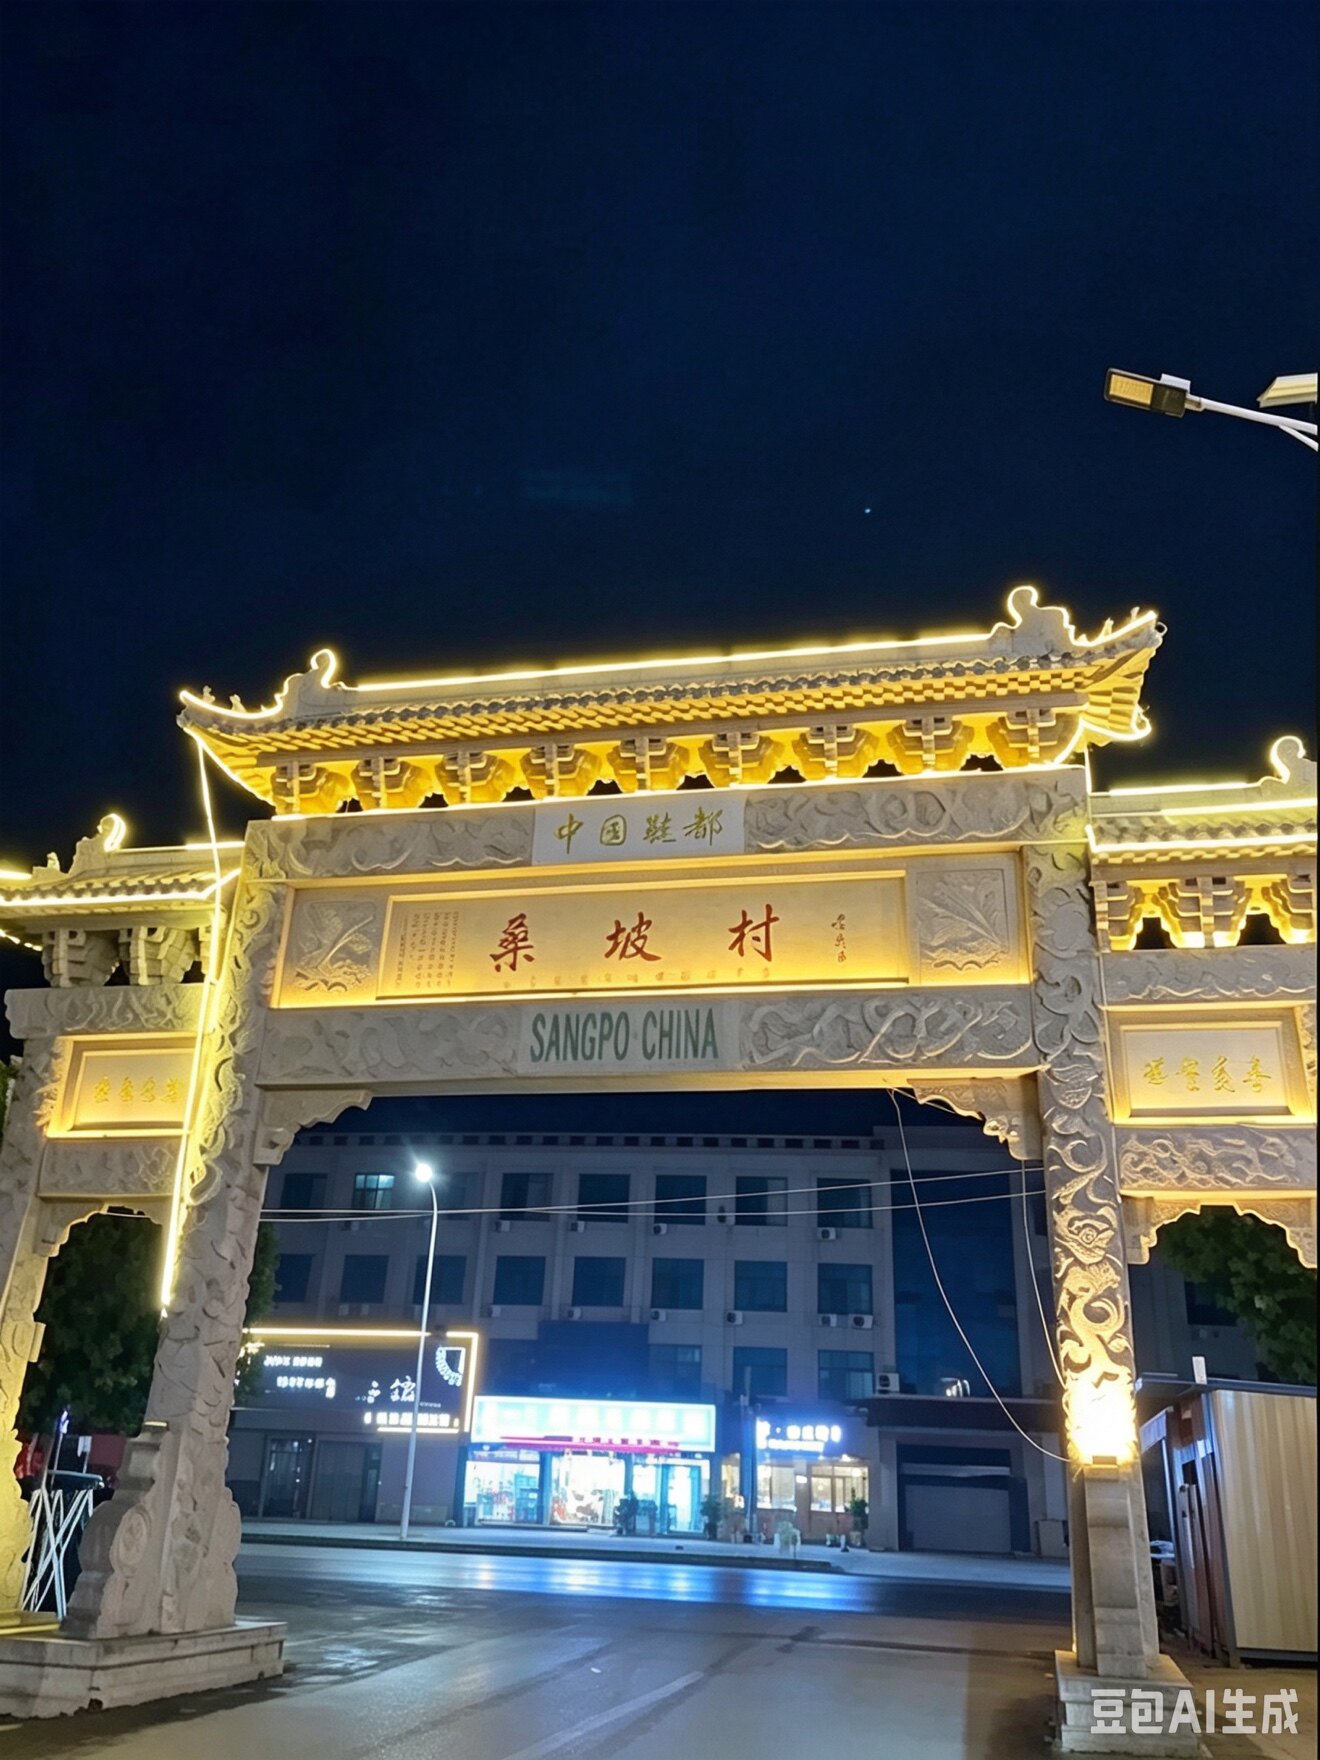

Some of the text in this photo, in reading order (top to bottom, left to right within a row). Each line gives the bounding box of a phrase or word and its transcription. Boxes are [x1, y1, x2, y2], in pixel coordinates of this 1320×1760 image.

[489, 903, 780, 973] 桑坡村
[530, 1008, 719, 1063] SANGPO CHINA
